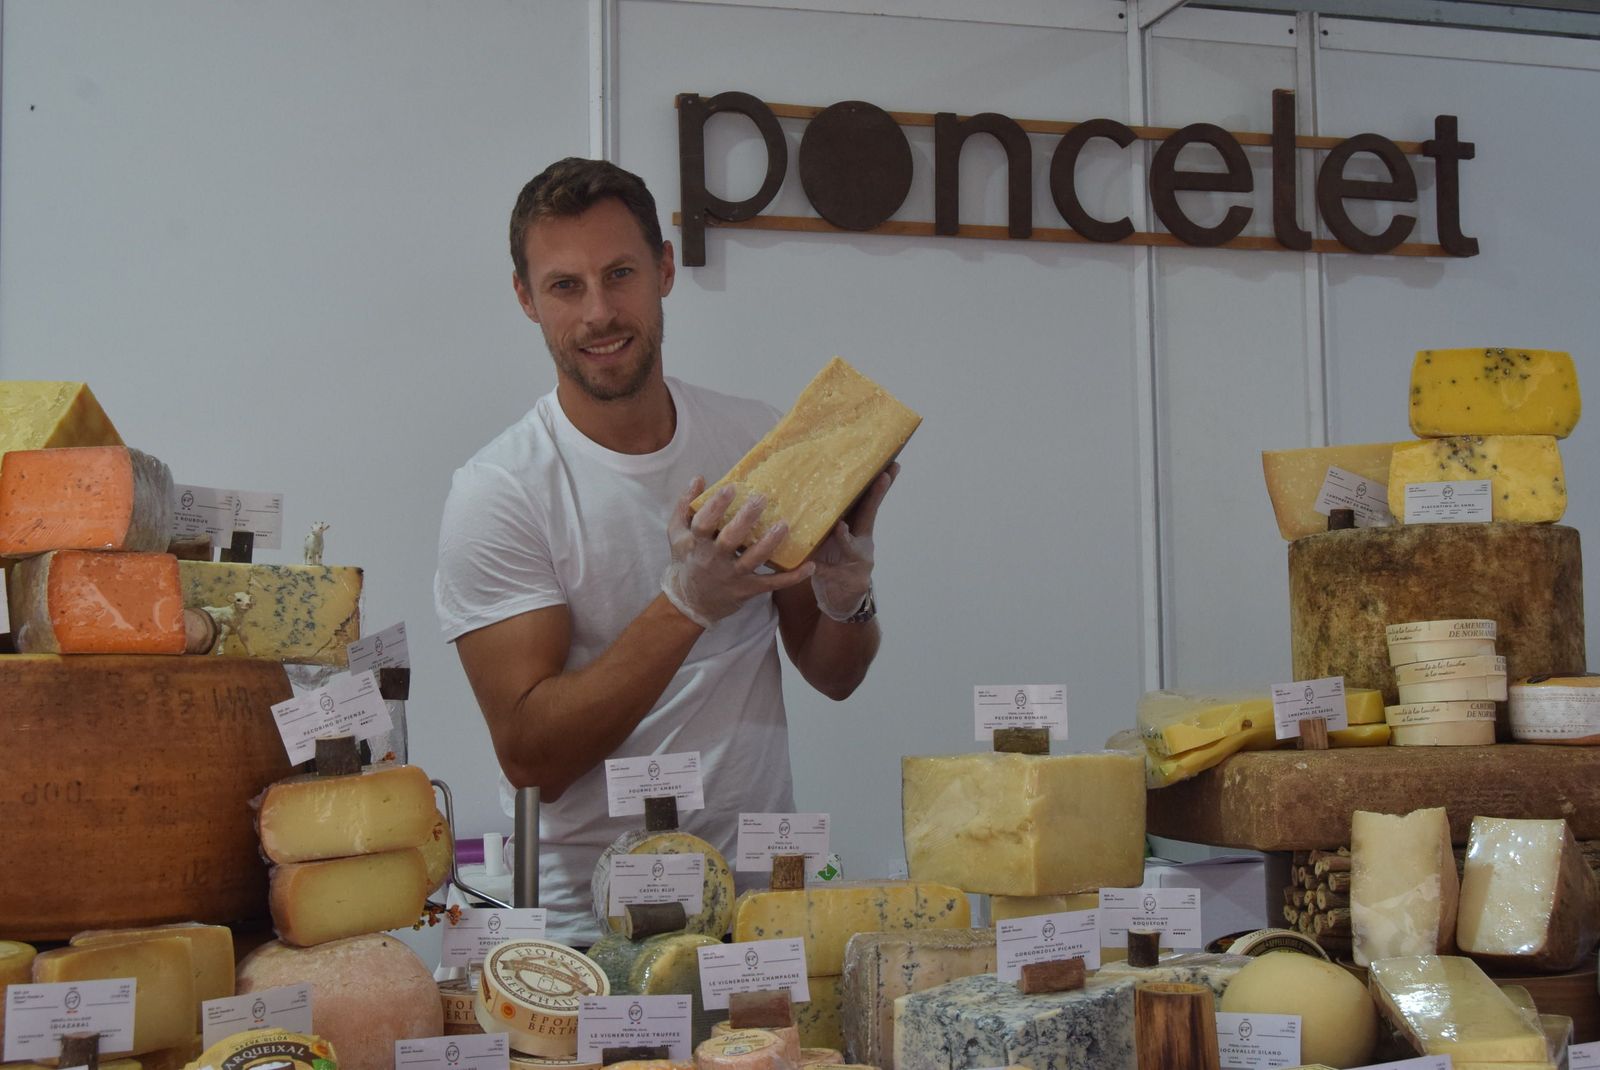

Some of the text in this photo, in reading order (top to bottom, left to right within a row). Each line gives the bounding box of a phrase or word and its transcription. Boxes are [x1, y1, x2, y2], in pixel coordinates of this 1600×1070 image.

[679, 89, 1480, 267] poncelet
[1448, 630, 1461, 638] DE
[303, 722, 334, 736] PECORINO
[343, 709, 366, 722] PIENZA
[1015, 948, 1056, 958] GORGONZOLA
[514, 948, 591, 978] EPOISSES
[762, 973, 800, 981] CHAMPAGNE
[446, 999, 473, 1010] POI
[446, 1011, 477, 1021] ERT
[530, 1013, 578, 1027] EPOIS
[528, 1022, 577, 1035] BERTH
[226, 1045, 305, 1070] ARQUEIXAL
